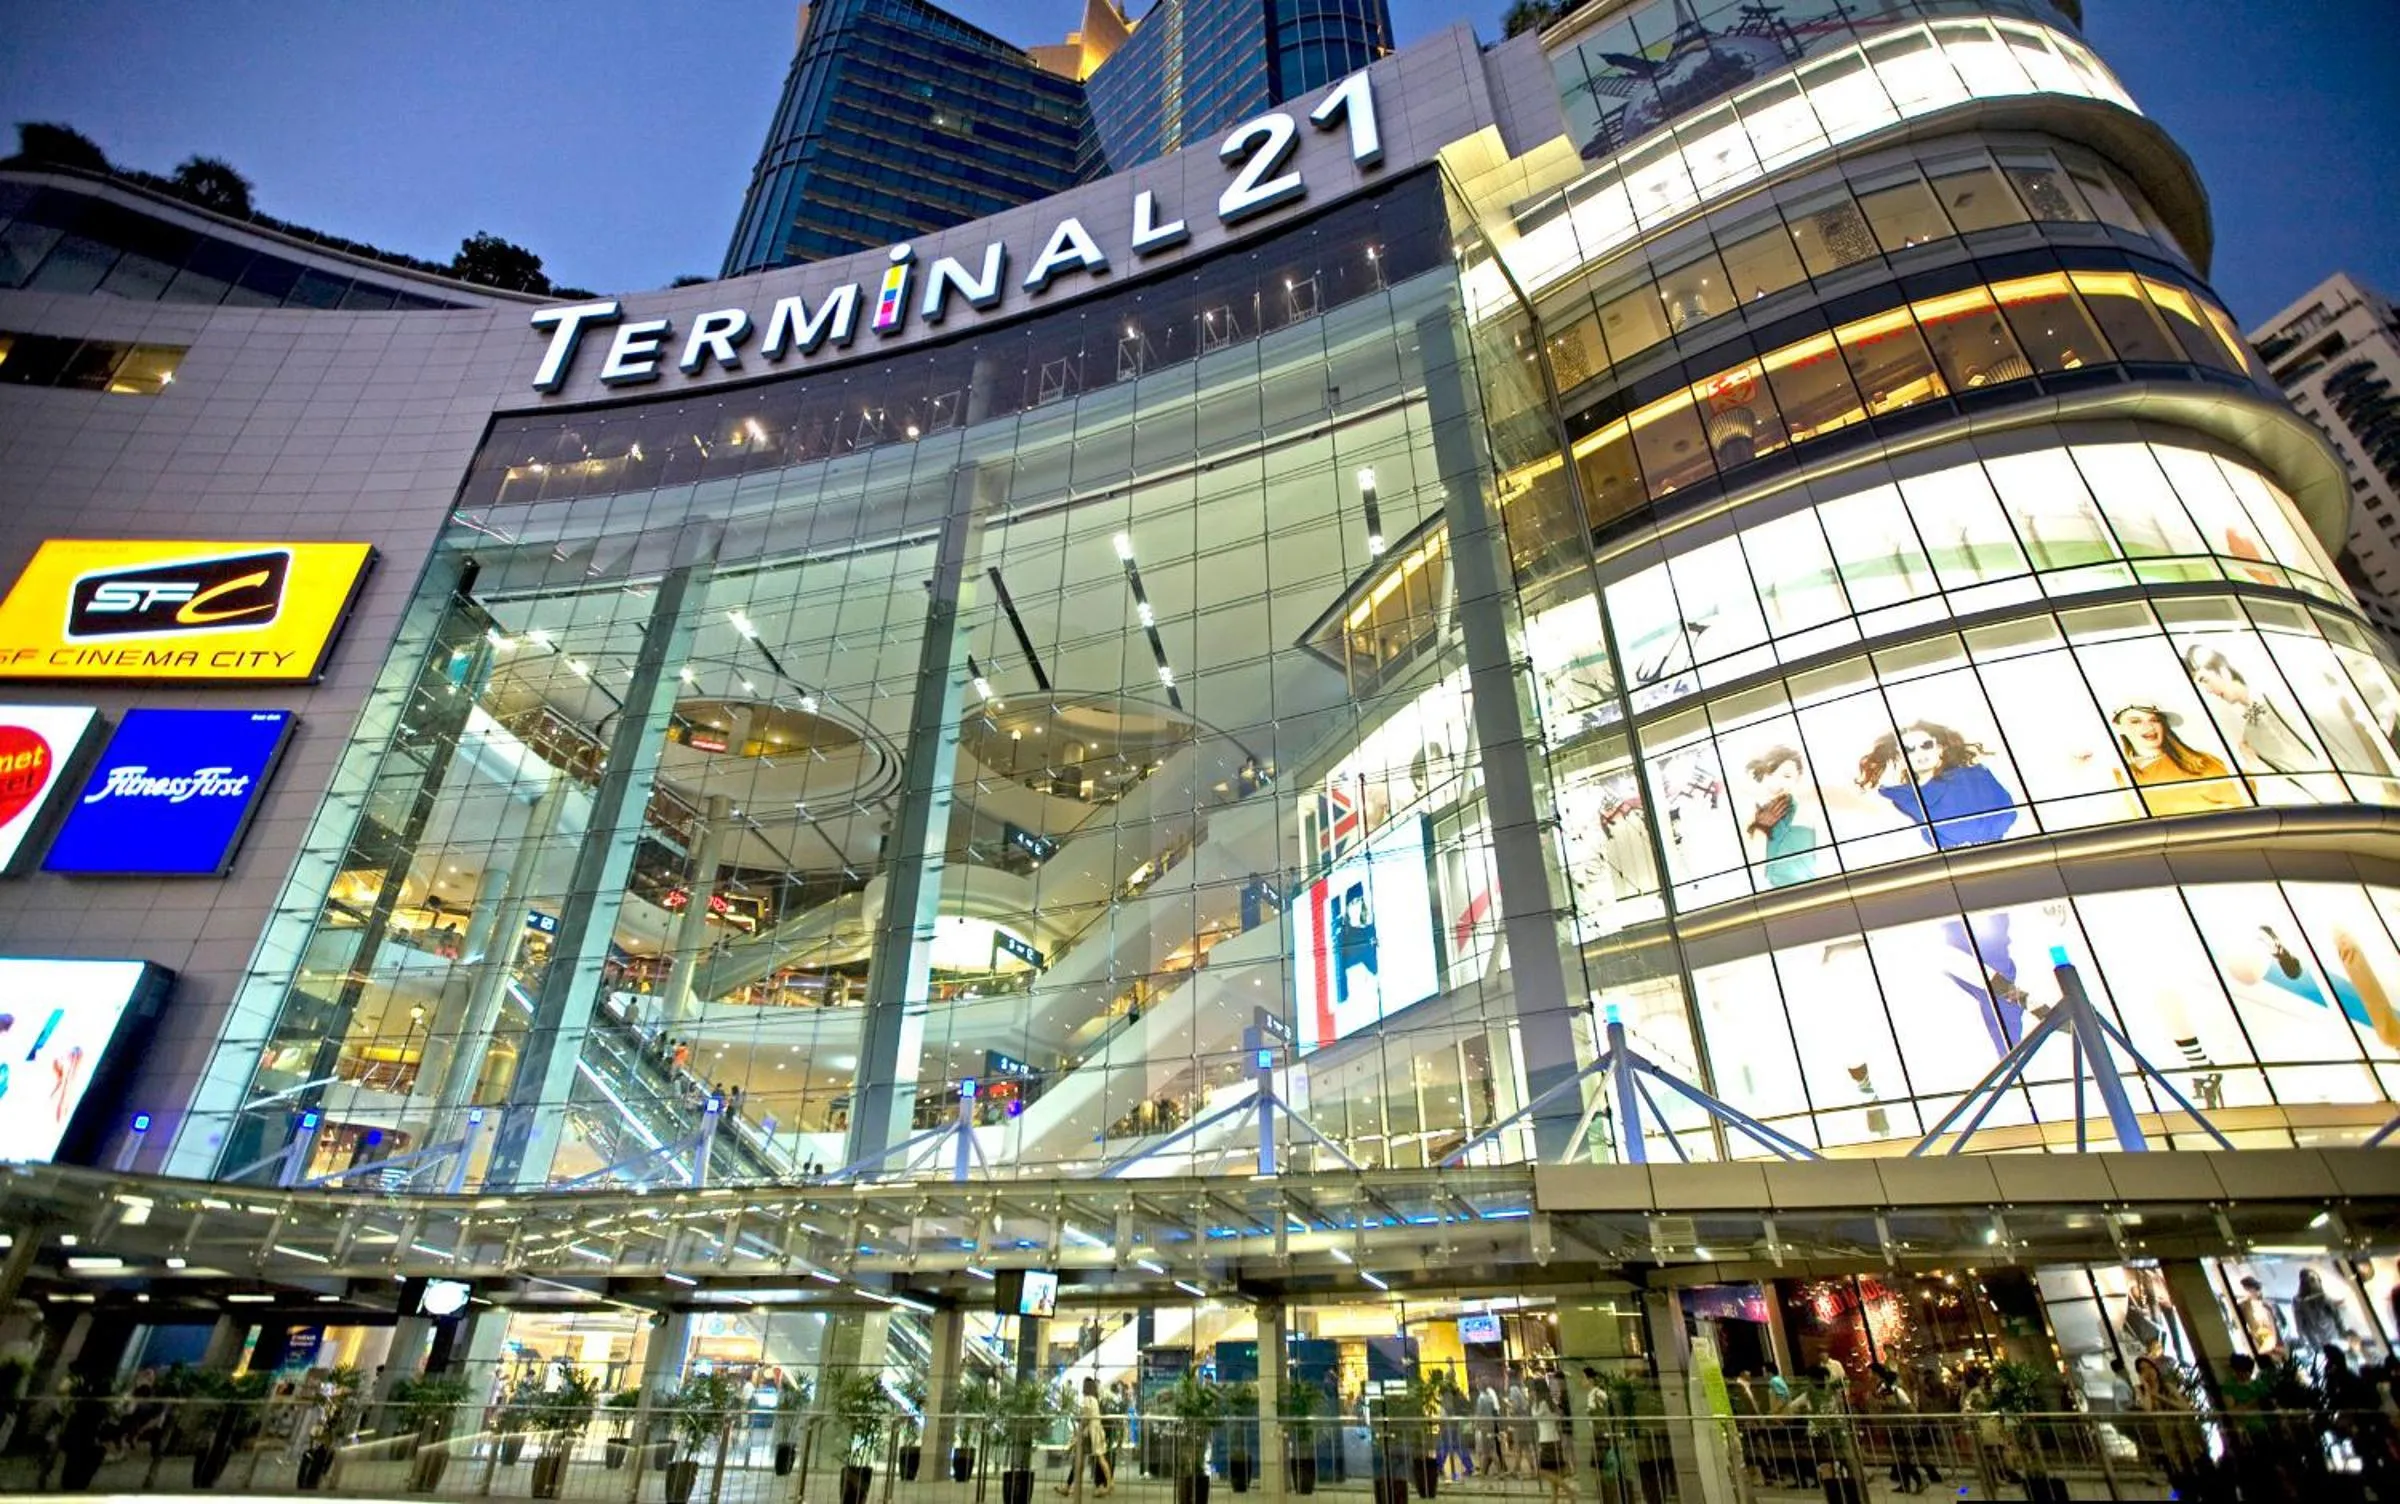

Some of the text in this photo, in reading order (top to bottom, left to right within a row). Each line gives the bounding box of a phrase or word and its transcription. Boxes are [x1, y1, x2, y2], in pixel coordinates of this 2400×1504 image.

[1217, 70, 1385, 223] 21
[49, 648, 199, 667] CINEMA
[210, 649, 296, 668] CITY
